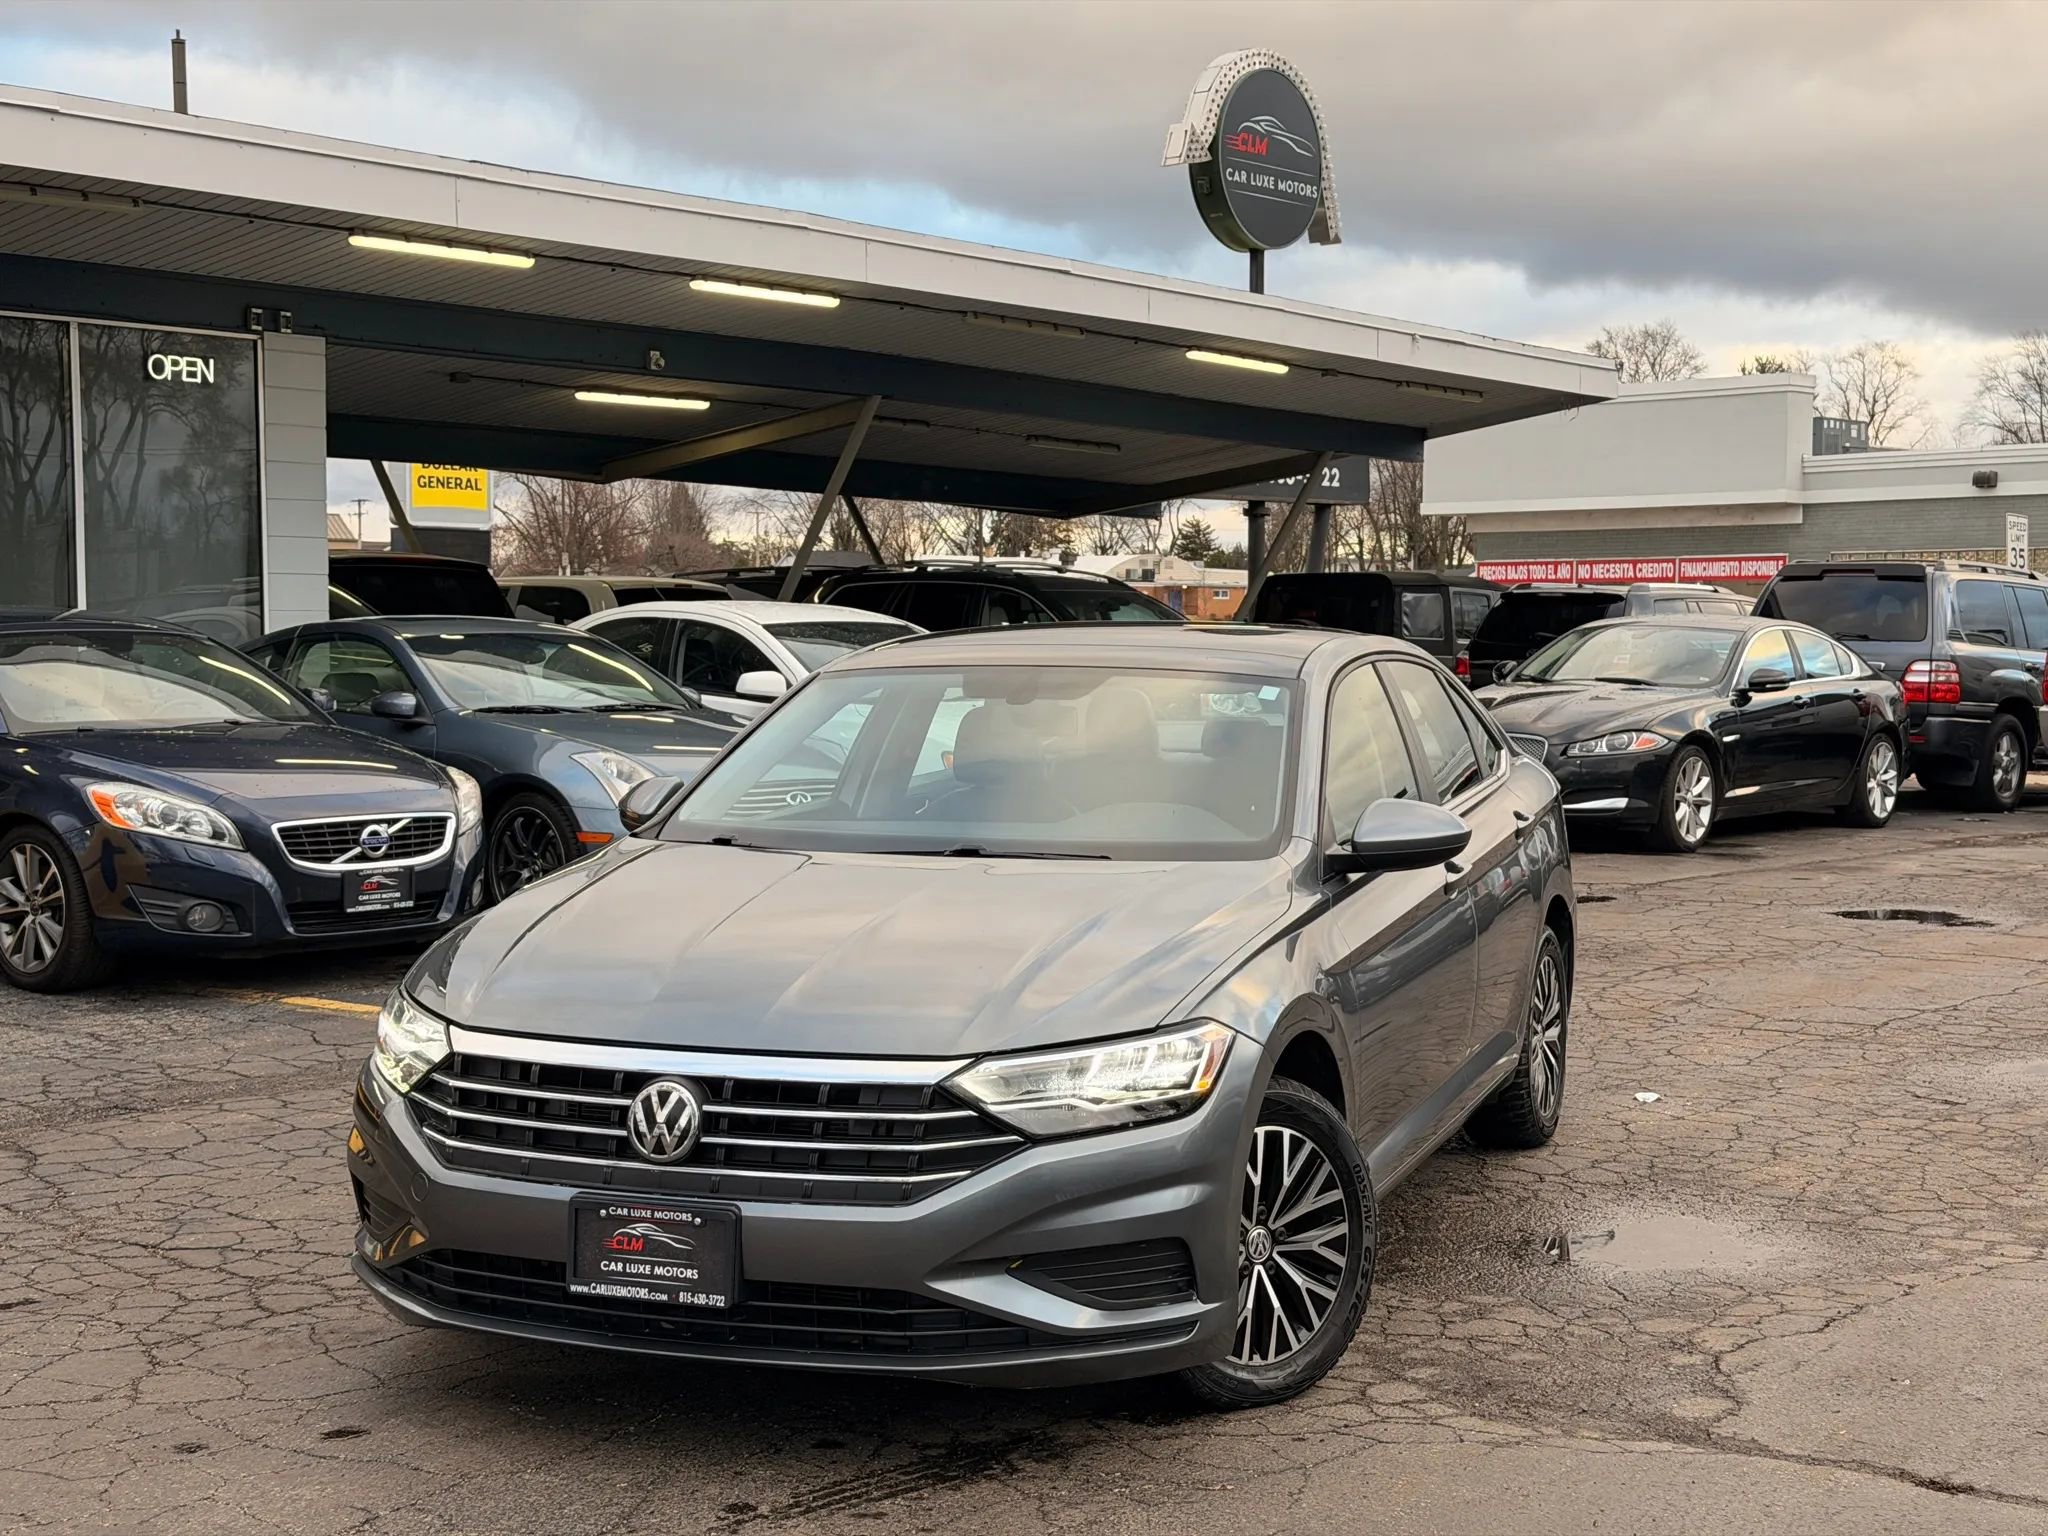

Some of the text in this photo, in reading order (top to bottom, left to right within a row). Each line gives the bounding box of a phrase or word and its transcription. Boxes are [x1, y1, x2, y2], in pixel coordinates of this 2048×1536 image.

[1238, 132, 1269, 156] CLM
[1226, 167, 1318, 199] CAR LUXE MOTORS
[147, 353, 215, 384] OPEN
[417, 474, 483, 491] GENERAL
[2008, 520, 2027, 532] SPEED
[2010, 547, 2026, 569] 35
[1479, 563, 1571, 580] PRECIOS BAJOS TODO EL AÑO
[1578, 562, 1674, 579] NO NECESITA CREDITO
[1680, 560, 1740, 577] FINANCIAMIENTO
[608, 1206, 692, 1222] CAR LUXE MOTORS
[612, 1235, 643, 1251] CLM
[600, 1260, 699, 1279] CAR LUXE MOTORS
[679, 1291, 725, 1307] 815-630-3722
